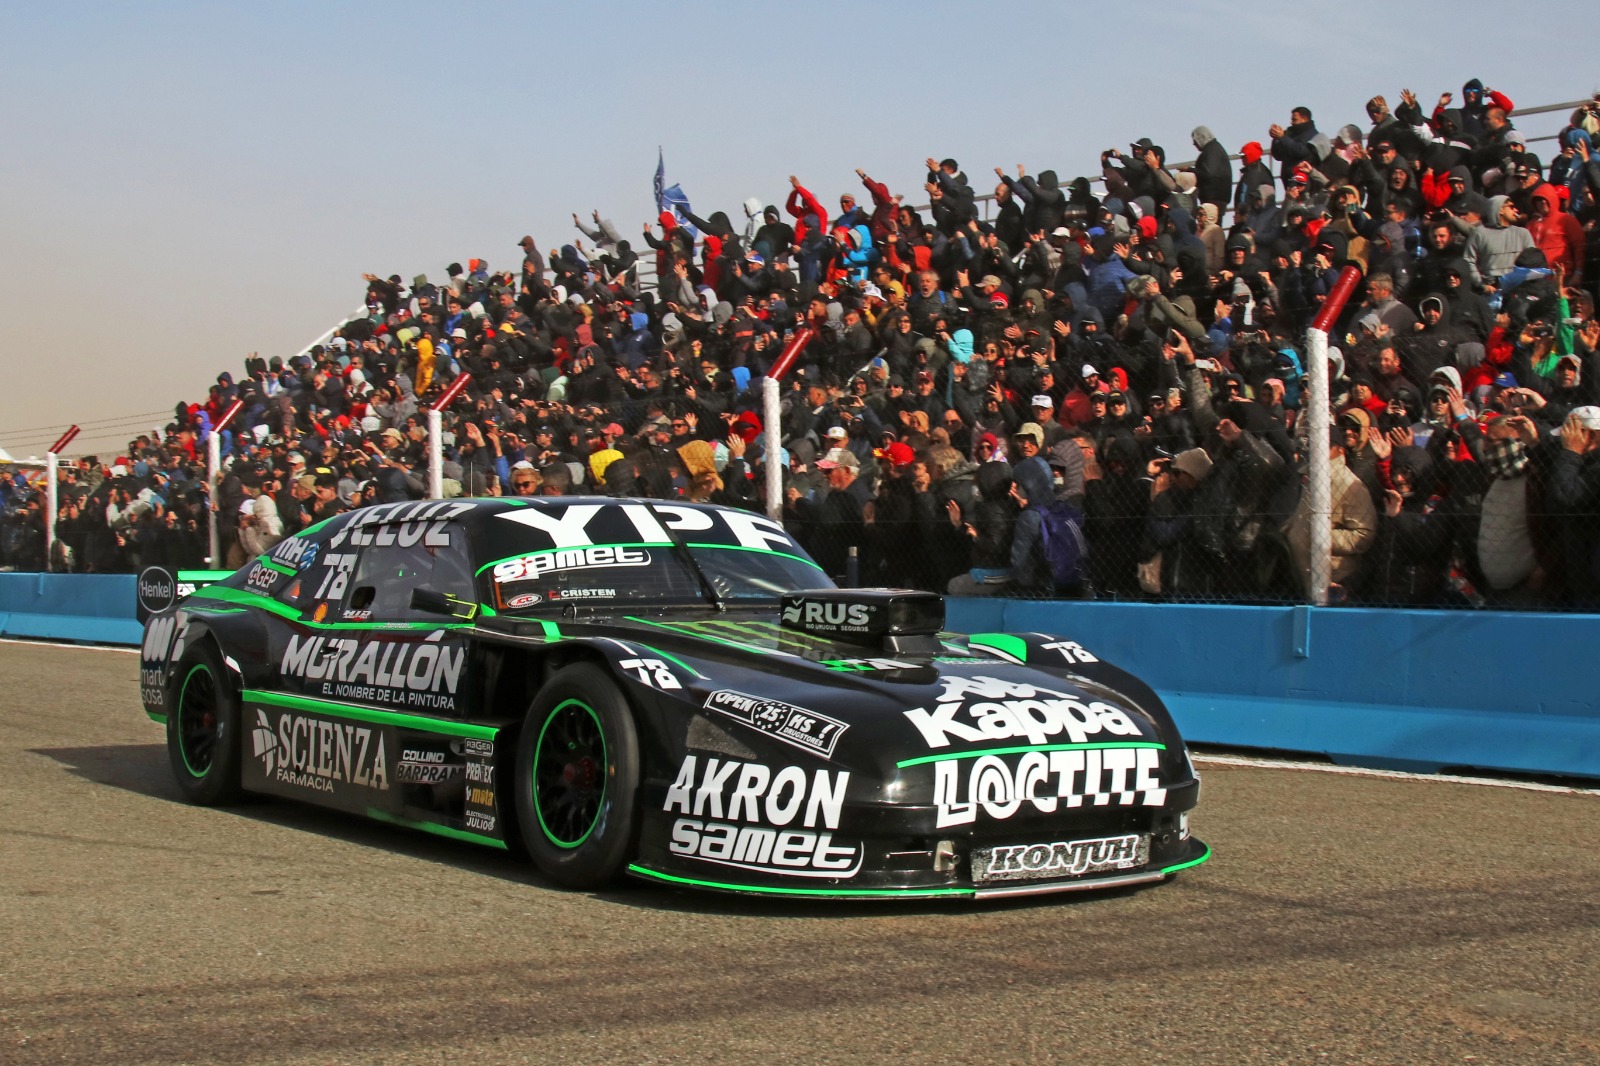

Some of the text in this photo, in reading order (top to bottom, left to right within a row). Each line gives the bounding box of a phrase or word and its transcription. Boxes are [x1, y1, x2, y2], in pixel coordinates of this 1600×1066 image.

[494, 504, 793, 550] YPF
[314, 554, 358, 599] 78
[494, 546, 644, 582] samet
[141, 581, 172, 598] Henkel
[561, 589, 616, 597] CRISTEM
[805, 602, 870, 626] RUS
[280, 630, 465, 694] MURALLÓN
[619, 658, 683, 689] 78
[322, 683, 455, 710] EL NOMBRE DE LA PINTURA
[715, 692, 757, 713] OPEN
[759, 705, 782, 723] 25
[783, 727, 824, 748] DRUGSTORES
[902, 700, 1143, 748] Kappa
[277, 713, 390, 790] SCIENZA
[402, 749, 446, 763] COLLINO
[277, 767, 334, 794] FARMACIA
[663, 755, 851, 830] AKRON
[669, 818, 857, 869] samet
[987, 834, 1140, 874] KONJUH
